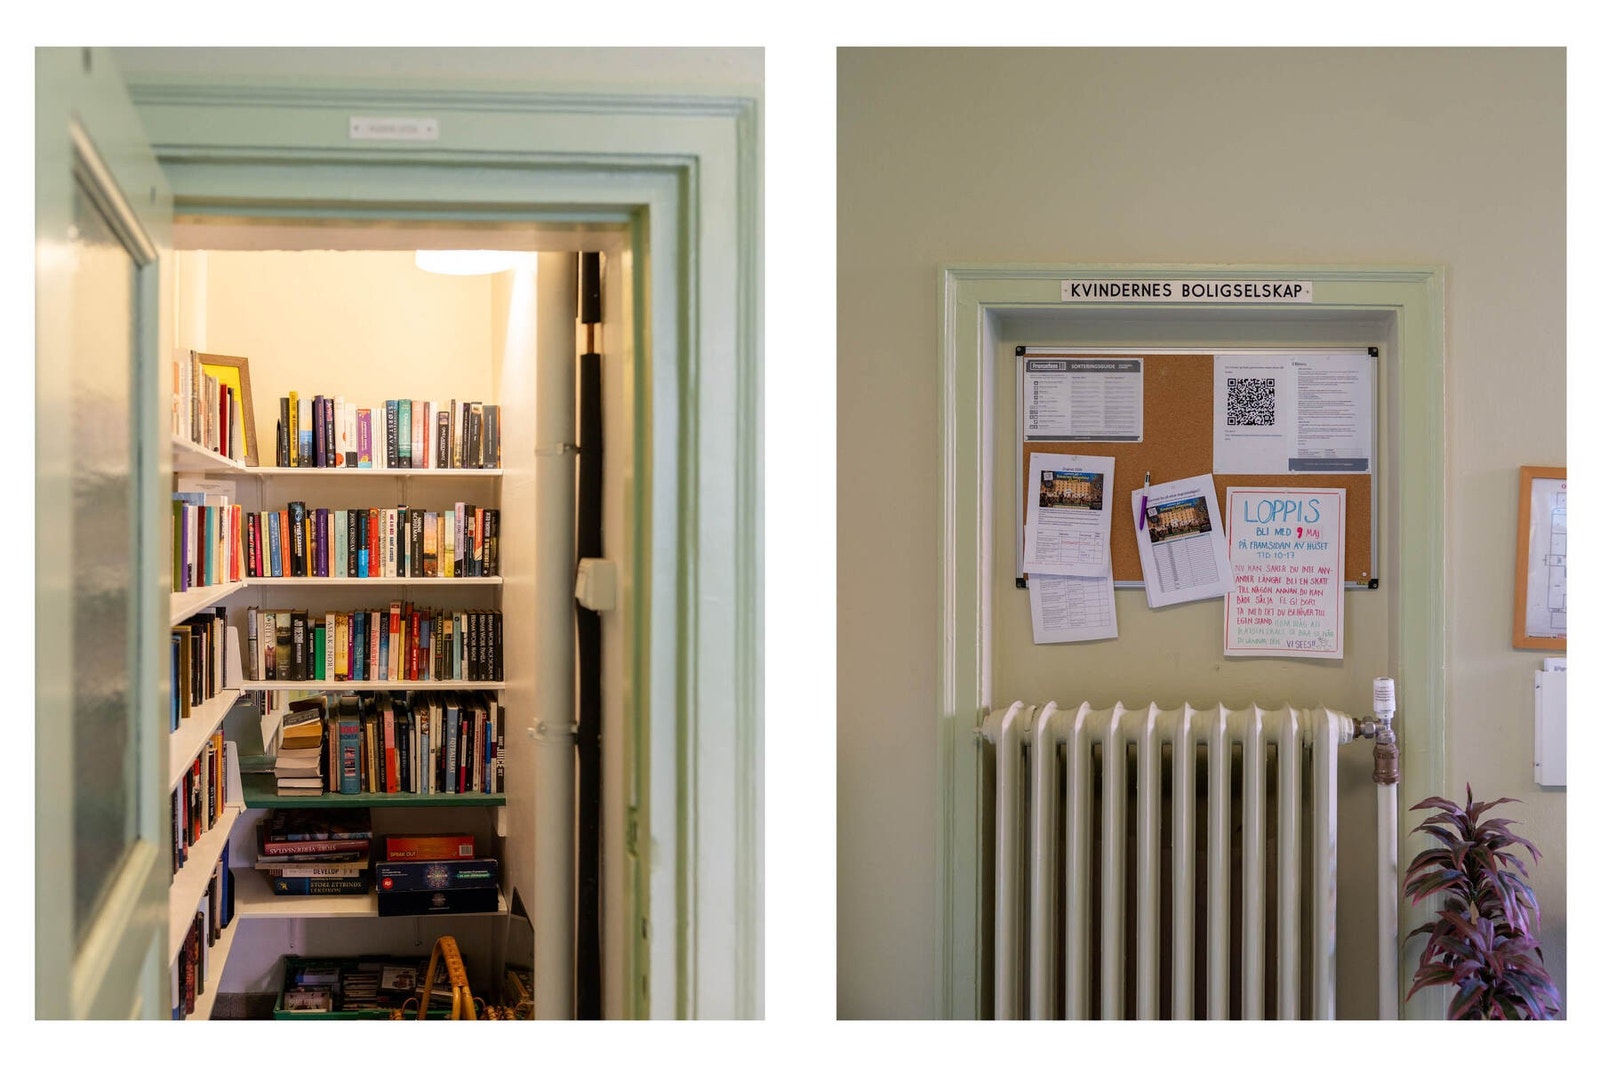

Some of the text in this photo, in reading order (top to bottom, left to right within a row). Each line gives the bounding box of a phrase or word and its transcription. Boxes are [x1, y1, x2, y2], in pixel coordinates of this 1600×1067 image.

[1071, 283, 1303, 299] KVINDERNES BOLIGSELSKAP
[1244, 498, 1320, 524] LOPPIS
[1256, 527, 1320, 539] BLI MED 9 MAJ
[1238, 538, 1328, 550] PÅ FRAMSIDAN AV HUSET
[1286, 640, 1293, 648] VI
